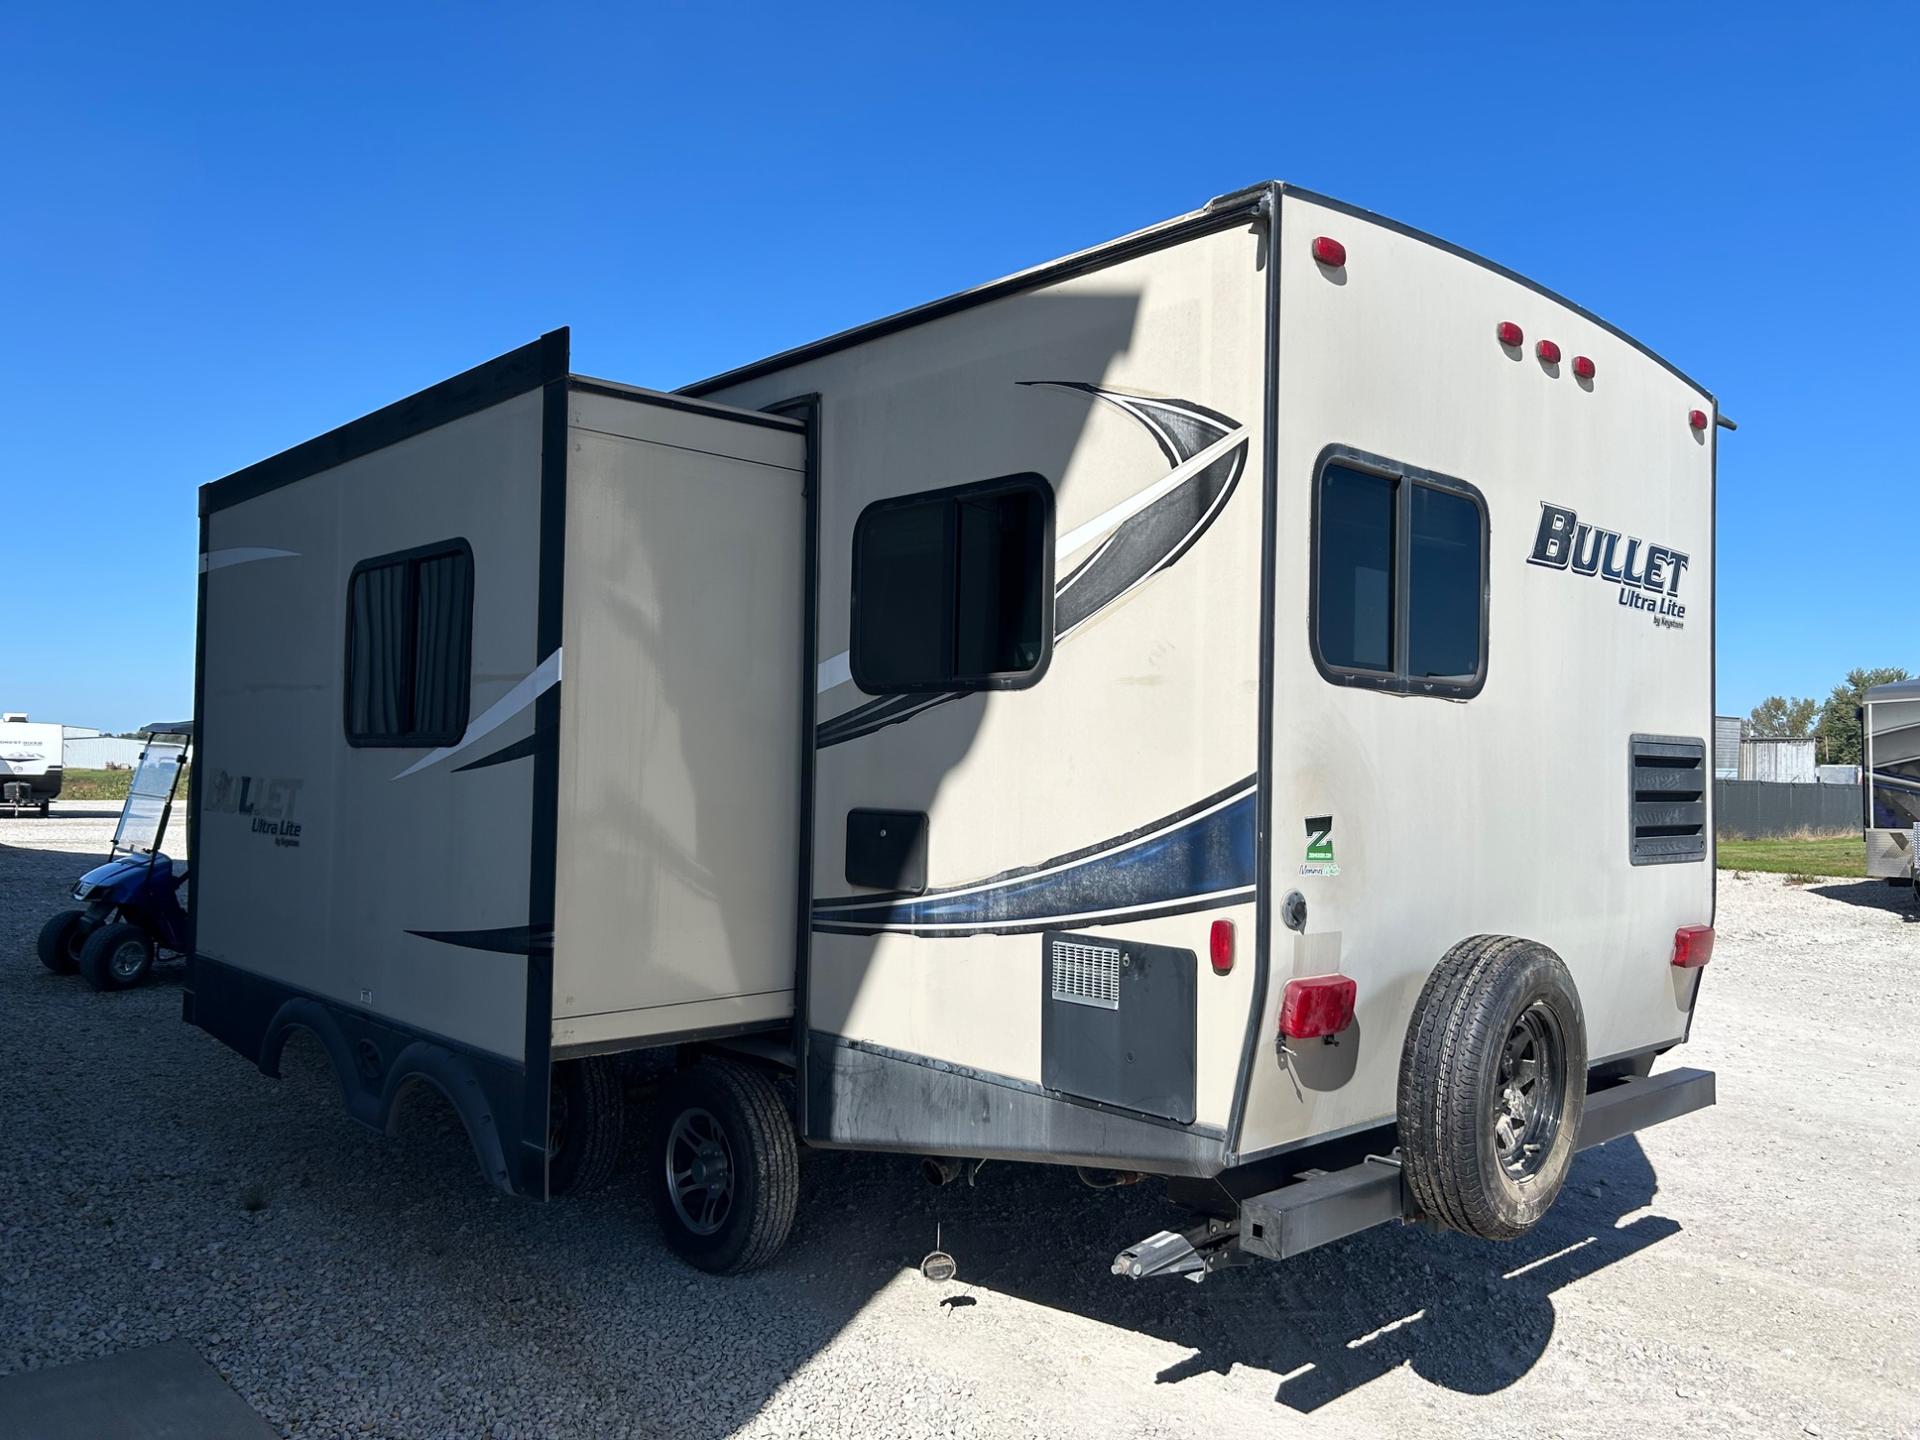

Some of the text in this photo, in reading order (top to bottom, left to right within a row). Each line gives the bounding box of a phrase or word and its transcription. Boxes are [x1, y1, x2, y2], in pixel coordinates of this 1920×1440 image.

[1526, 501, 1690, 597] BULLET
[1618, 587, 1685, 618] Ultra Lite
[1653, 615, 1661, 627] by
[251, 817, 302, 837] Ultra Lite
